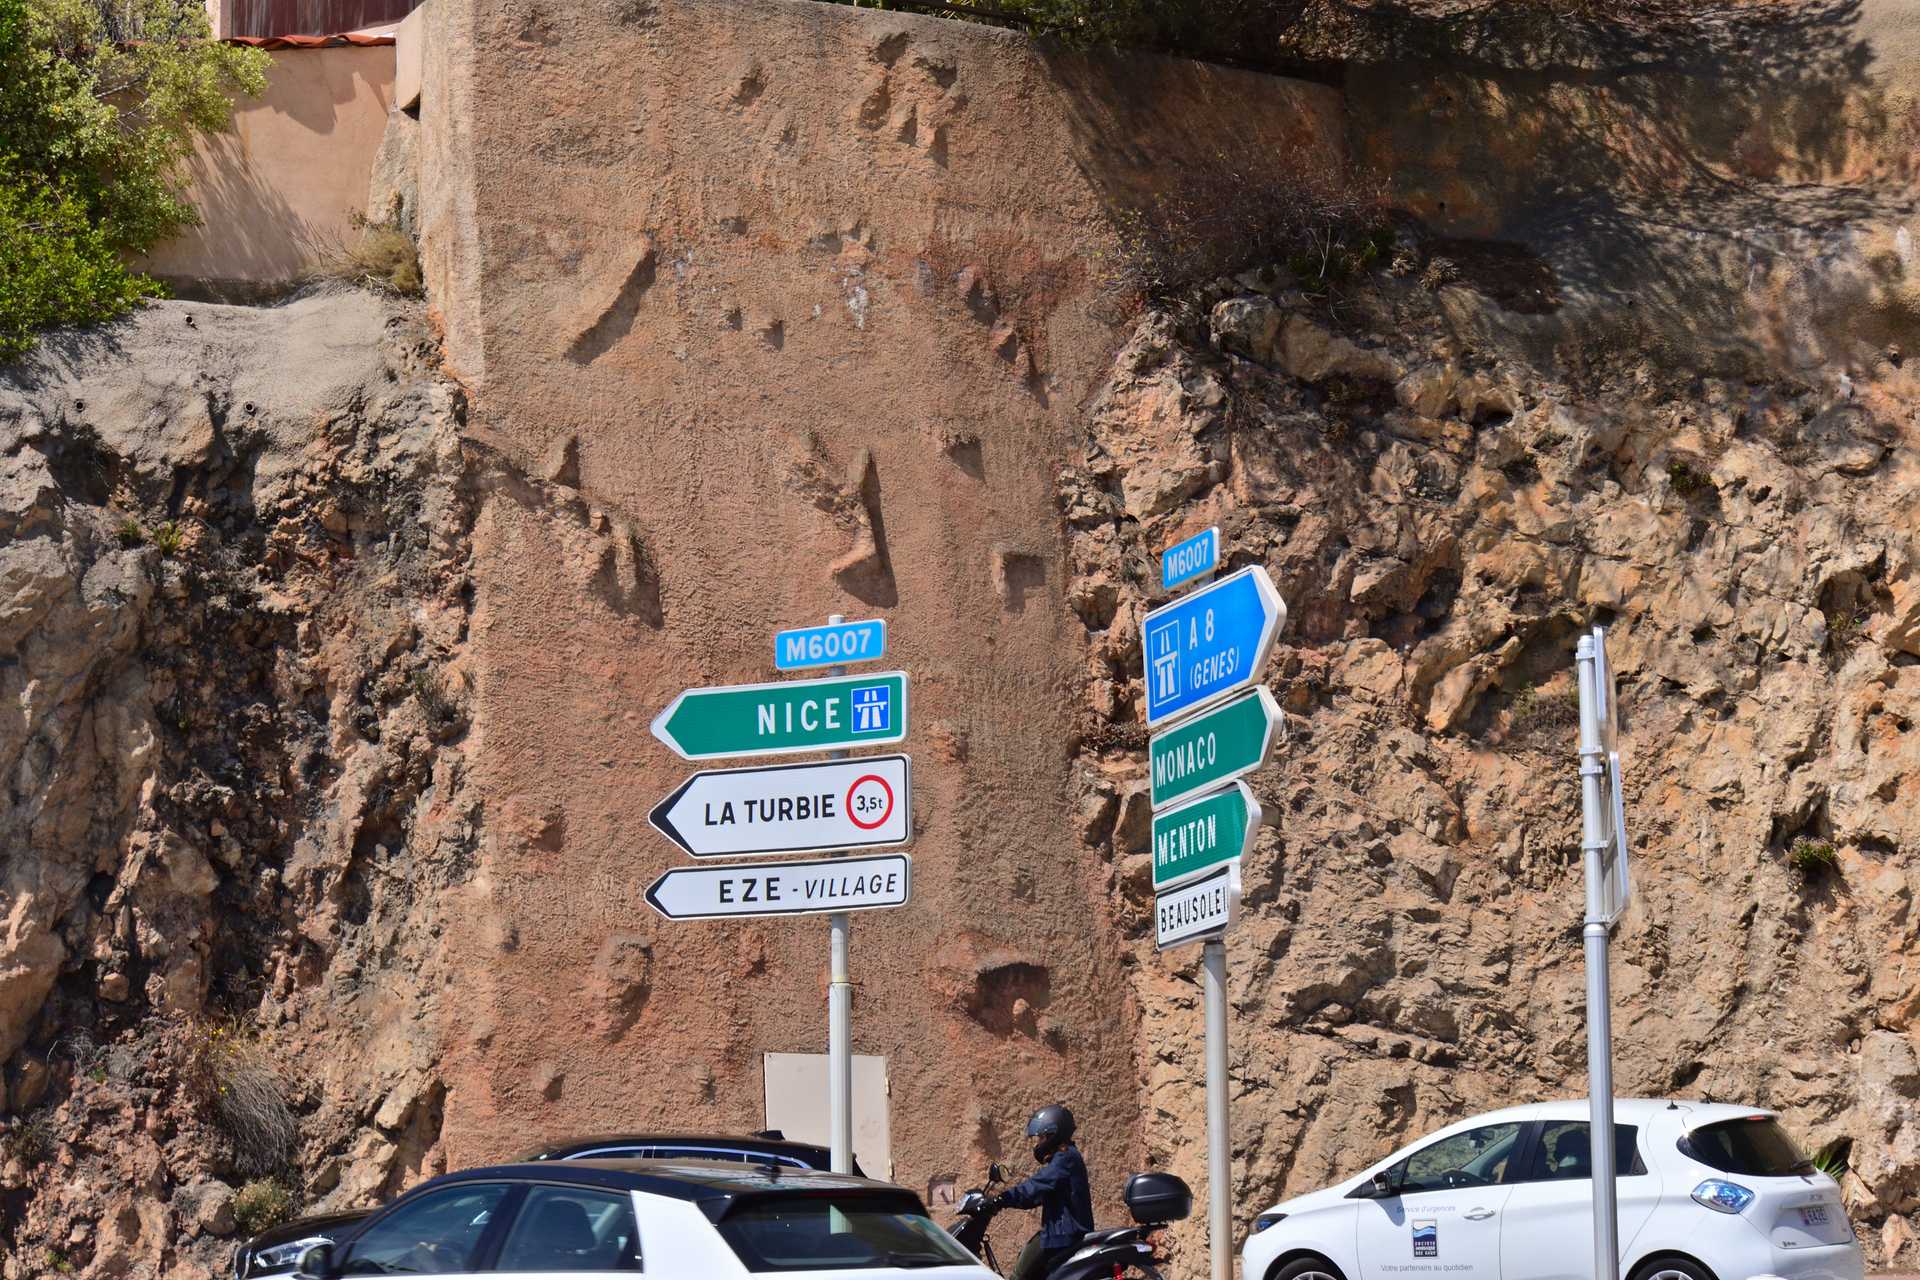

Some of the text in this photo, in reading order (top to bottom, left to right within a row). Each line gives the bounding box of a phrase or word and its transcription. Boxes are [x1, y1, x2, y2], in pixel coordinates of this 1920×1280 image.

[1167, 537, 1209, 581] M6007
[786, 628, 872, 662] M6007
[1189, 645, 1240, 690] (GENES)
[757, 698, 841, 735] NICE
[1156, 731, 1216, 788] MONACO
[704, 793, 836, 826] LA TURBIE
[856, 795, 883, 814] 3,5t
[1158, 814, 1217, 867] MENTON
